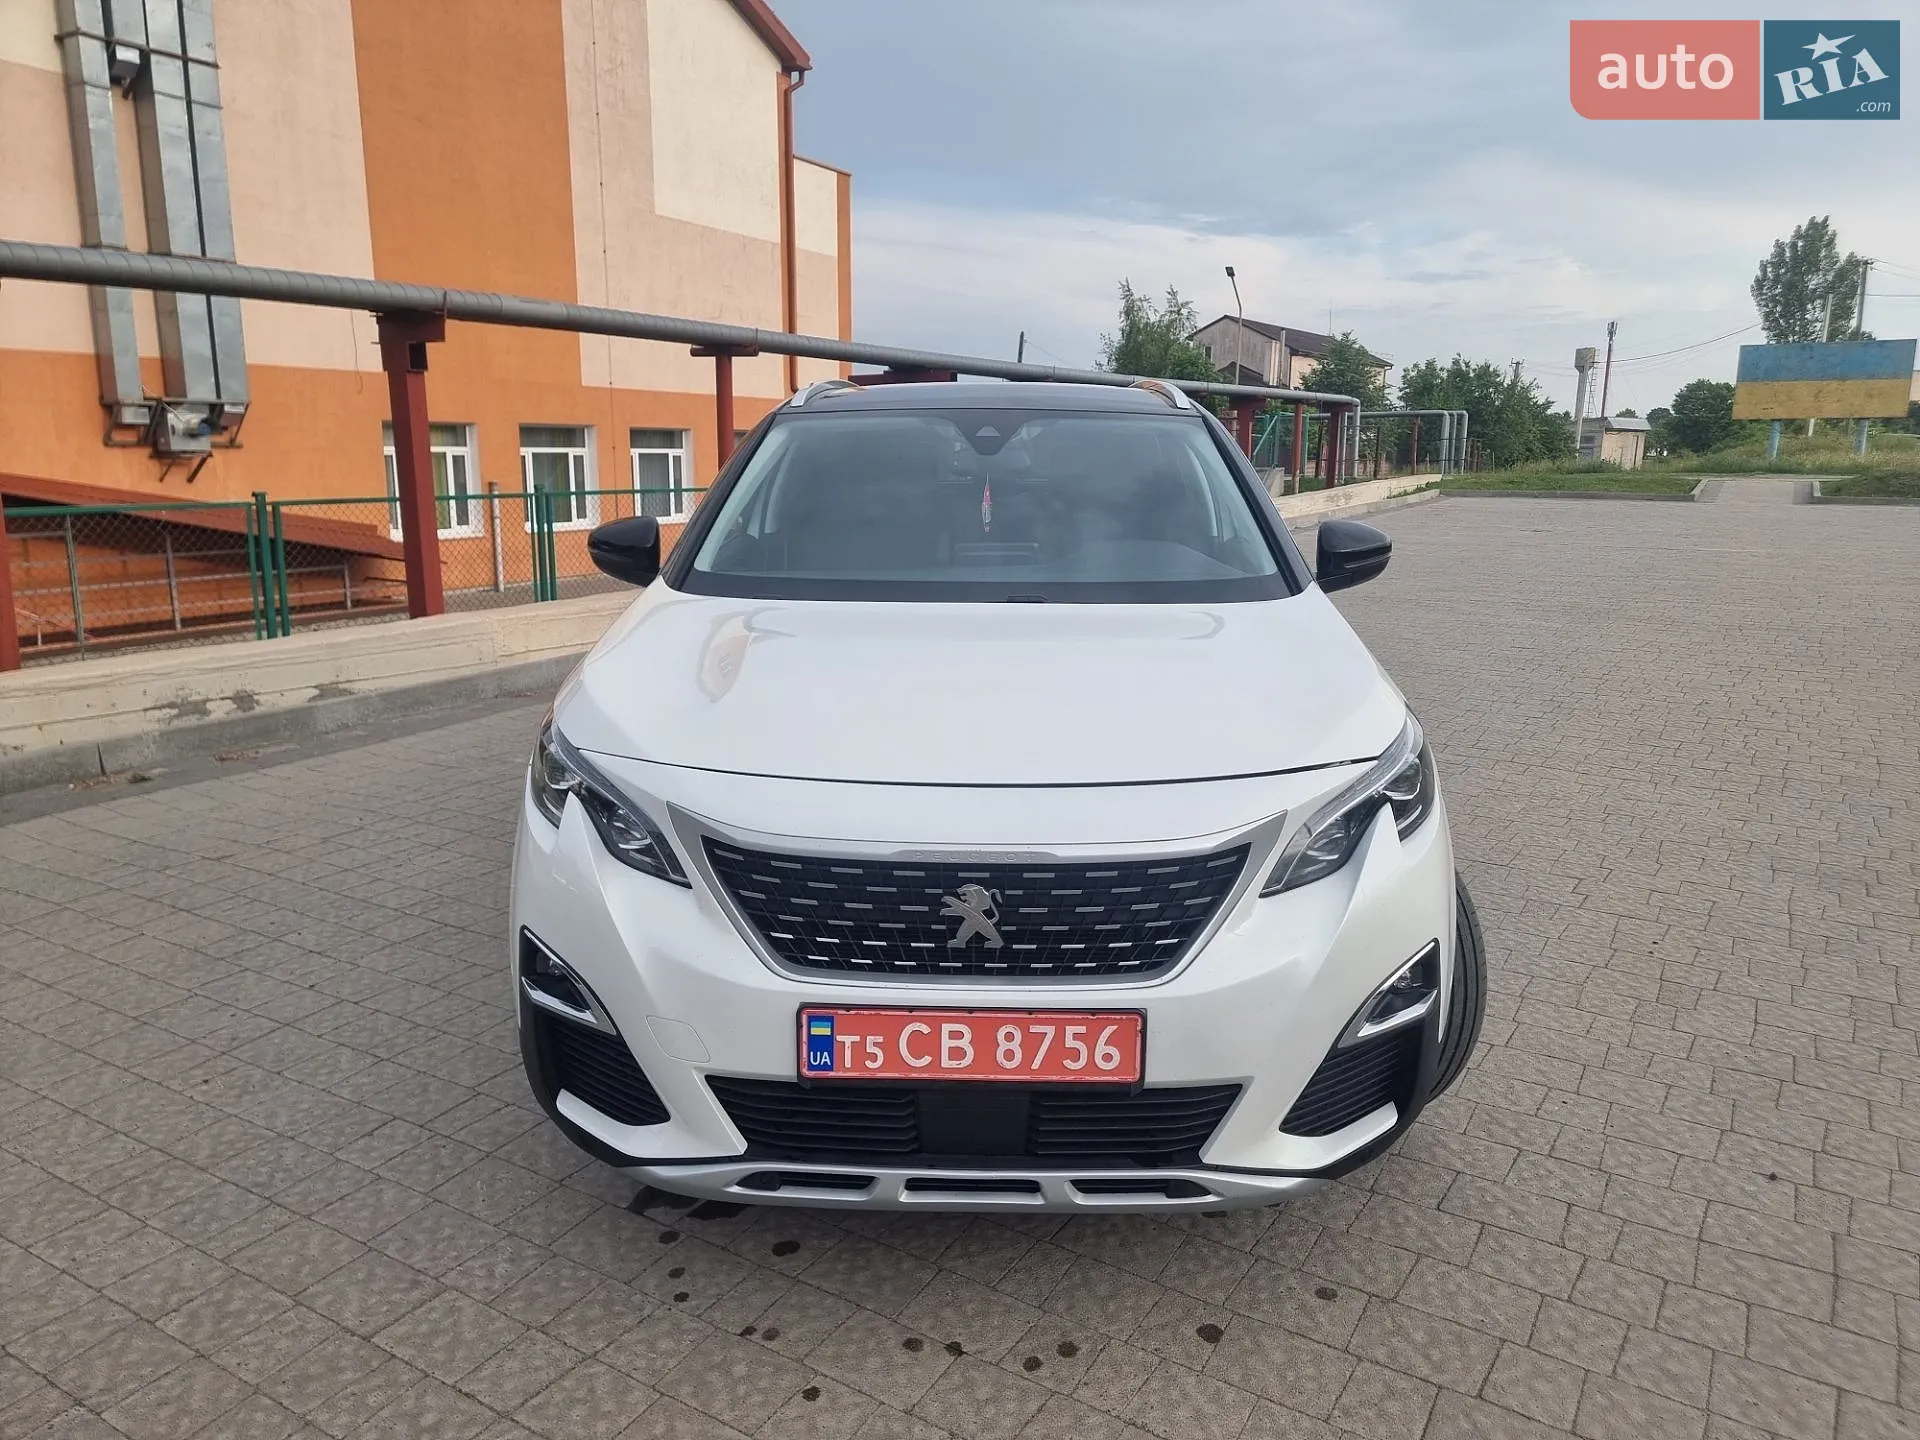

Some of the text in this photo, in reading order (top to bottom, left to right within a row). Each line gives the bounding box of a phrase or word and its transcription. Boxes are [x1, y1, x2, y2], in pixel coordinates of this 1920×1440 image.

[913, 851, 1035, 862] PEUGEOT
[836, 1022, 1121, 1071] T5 CB 8756
[809, 1050, 831, 1066] UA
